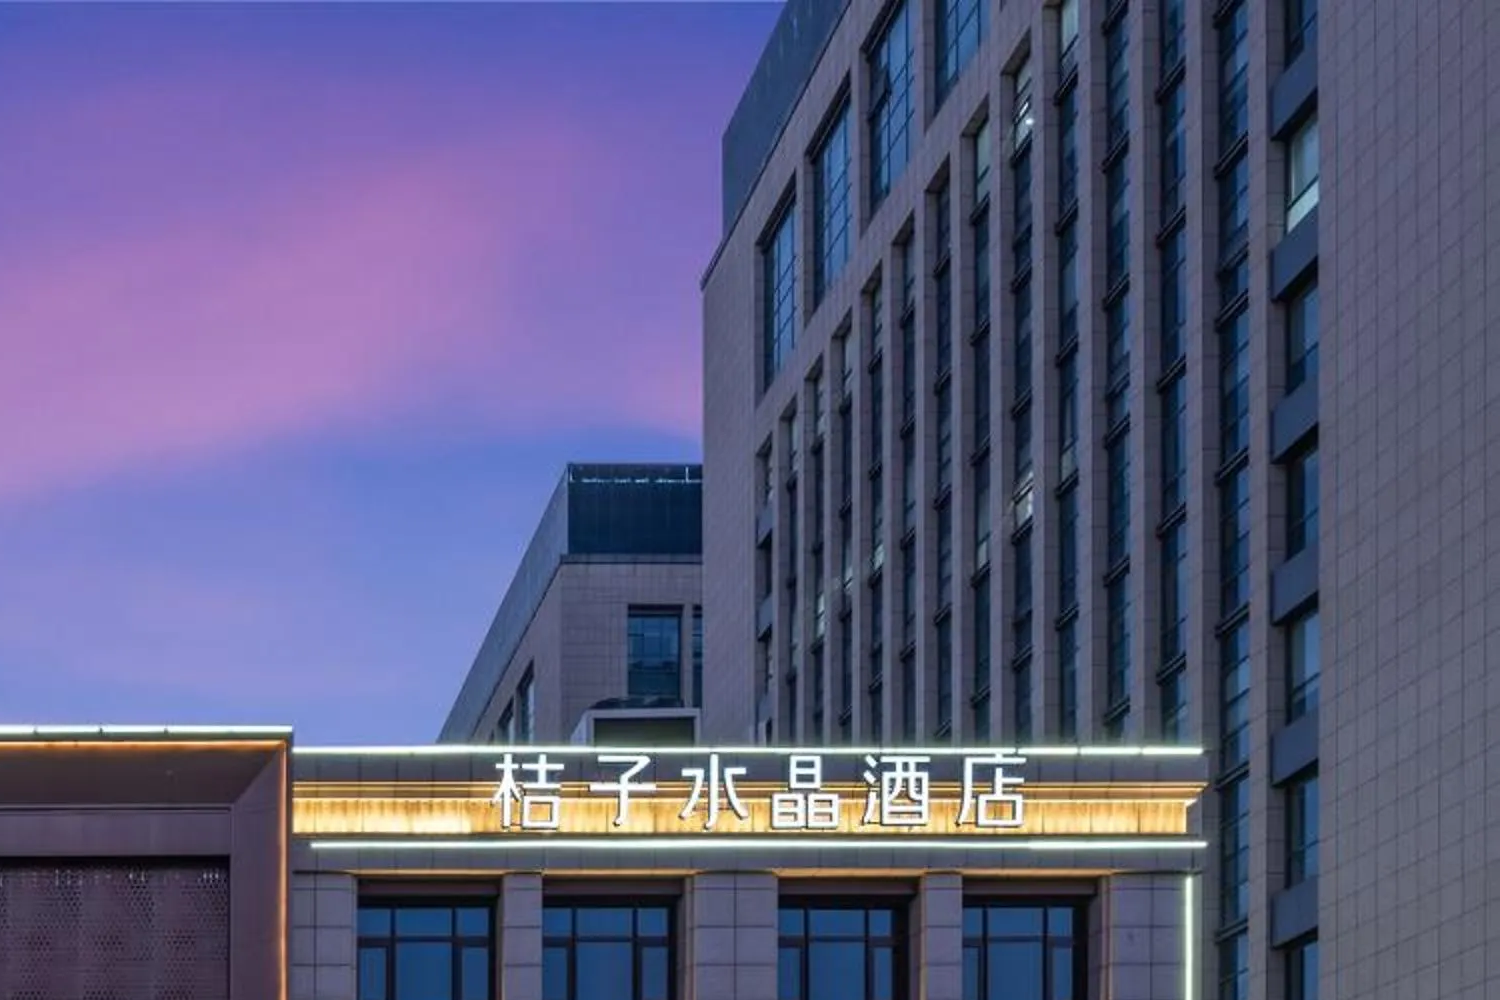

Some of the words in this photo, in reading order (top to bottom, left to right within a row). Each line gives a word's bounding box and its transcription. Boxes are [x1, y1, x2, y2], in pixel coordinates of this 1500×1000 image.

[491, 753, 1027, 829] 桔子水晶酒店
